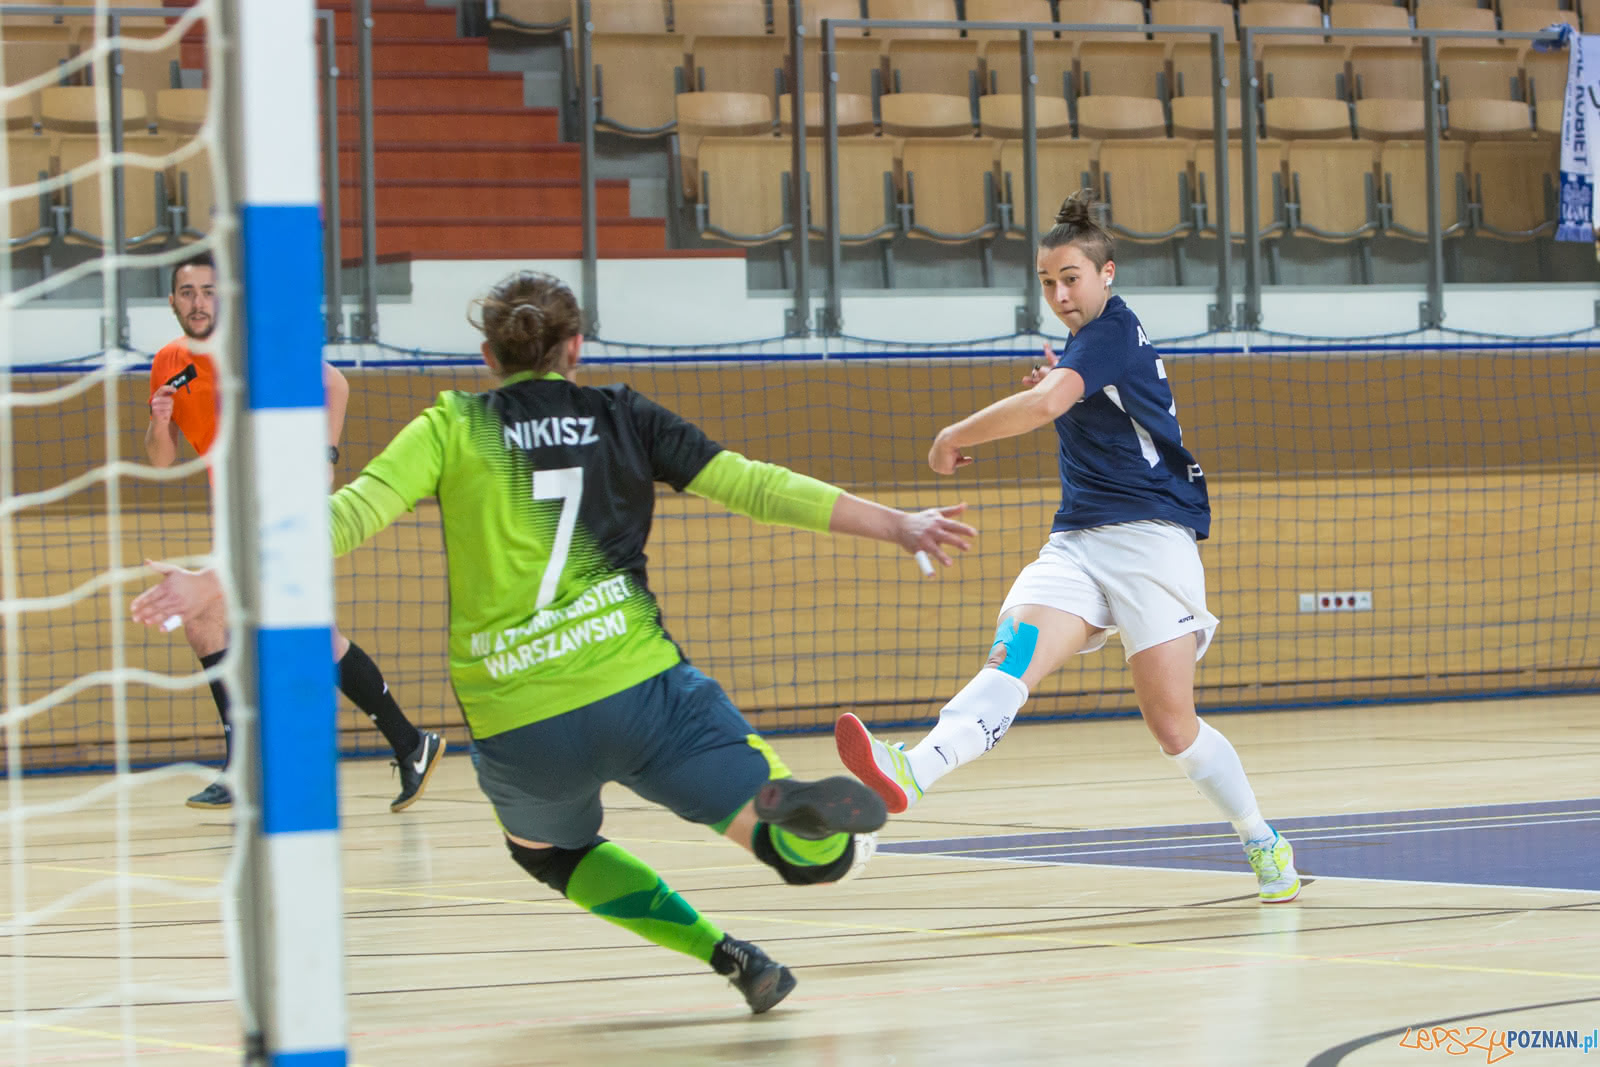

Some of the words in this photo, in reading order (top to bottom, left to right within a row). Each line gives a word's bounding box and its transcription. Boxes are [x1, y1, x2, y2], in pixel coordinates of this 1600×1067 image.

[503, 416, 600, 450] NIKISZ
[532, 466, 584, 611] 7
[483, 609, 627, 680] WARSZAWSKI
